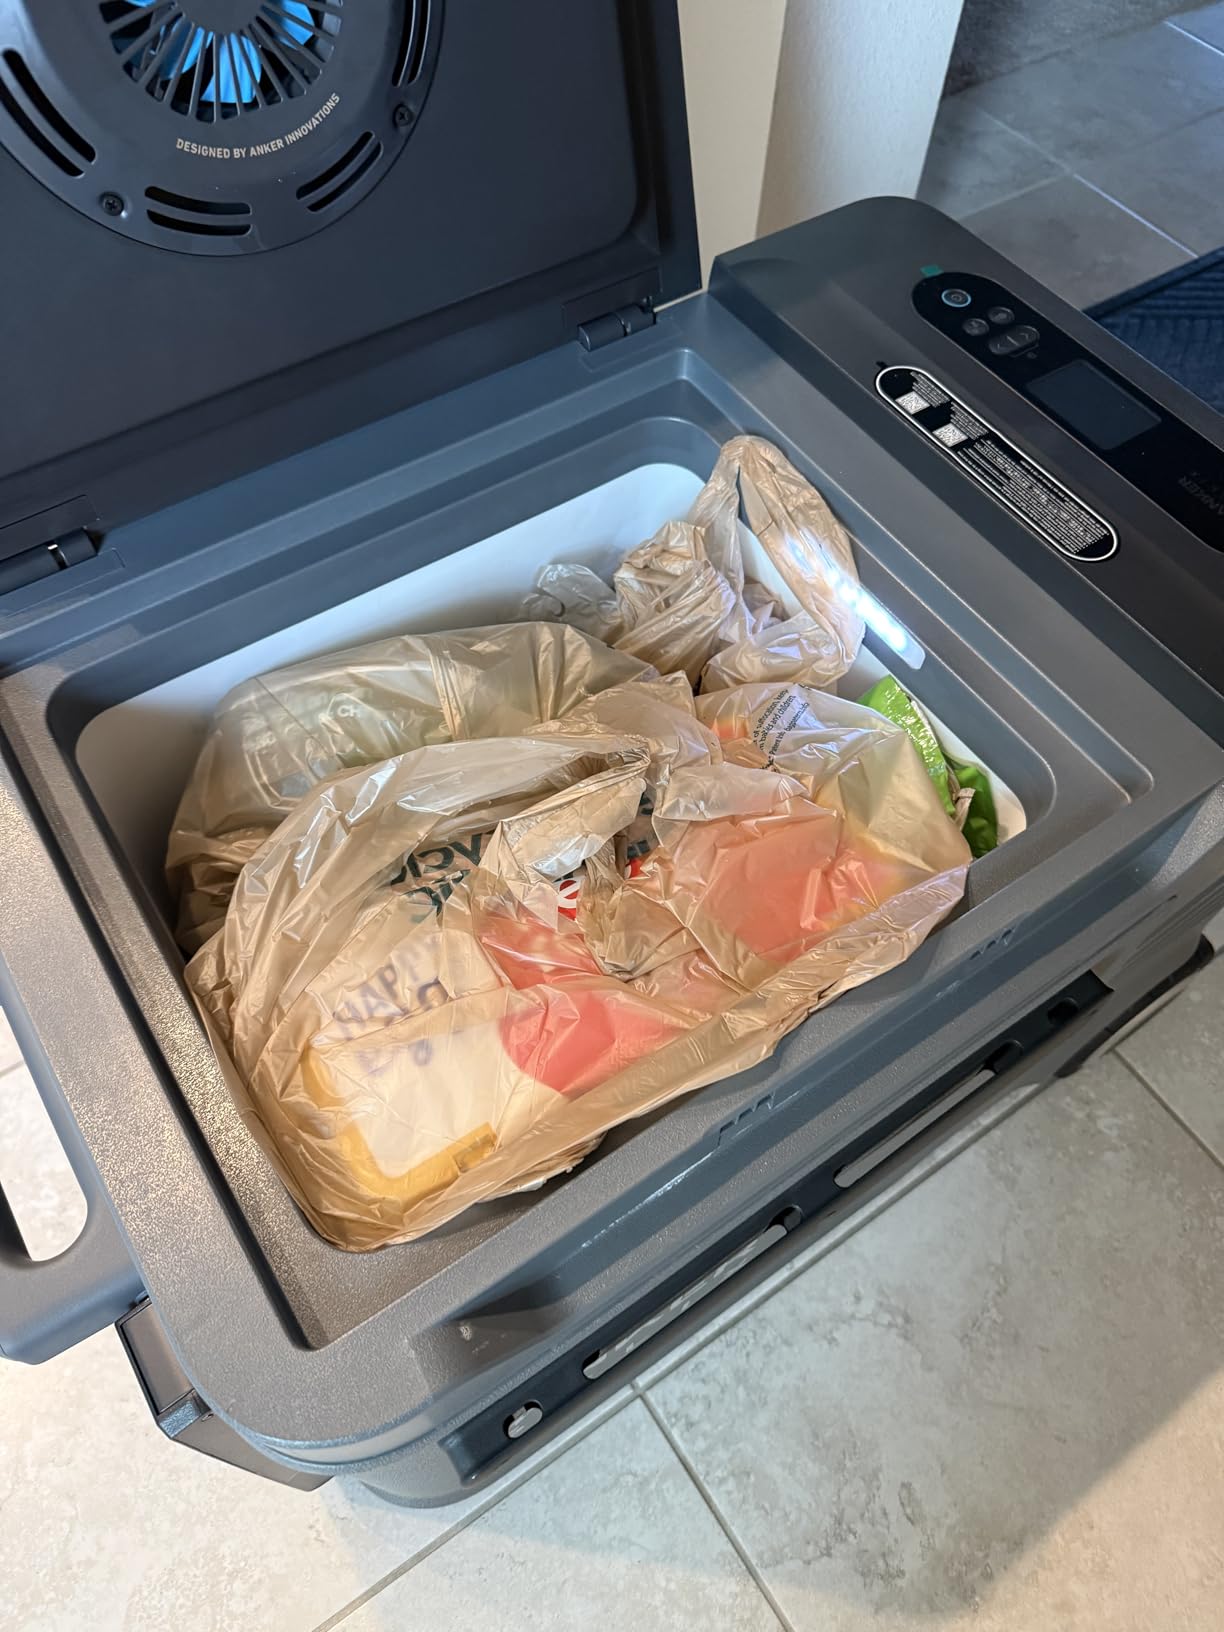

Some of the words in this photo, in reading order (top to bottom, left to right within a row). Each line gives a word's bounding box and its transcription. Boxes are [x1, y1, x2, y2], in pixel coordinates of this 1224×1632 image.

[176, 138, 231, 159] DESIGNED
[233, 147, 247, 159] BY
[249, 138, 285, 157] ANKER
[285, 92, 341, 145] INNOVATIONS
